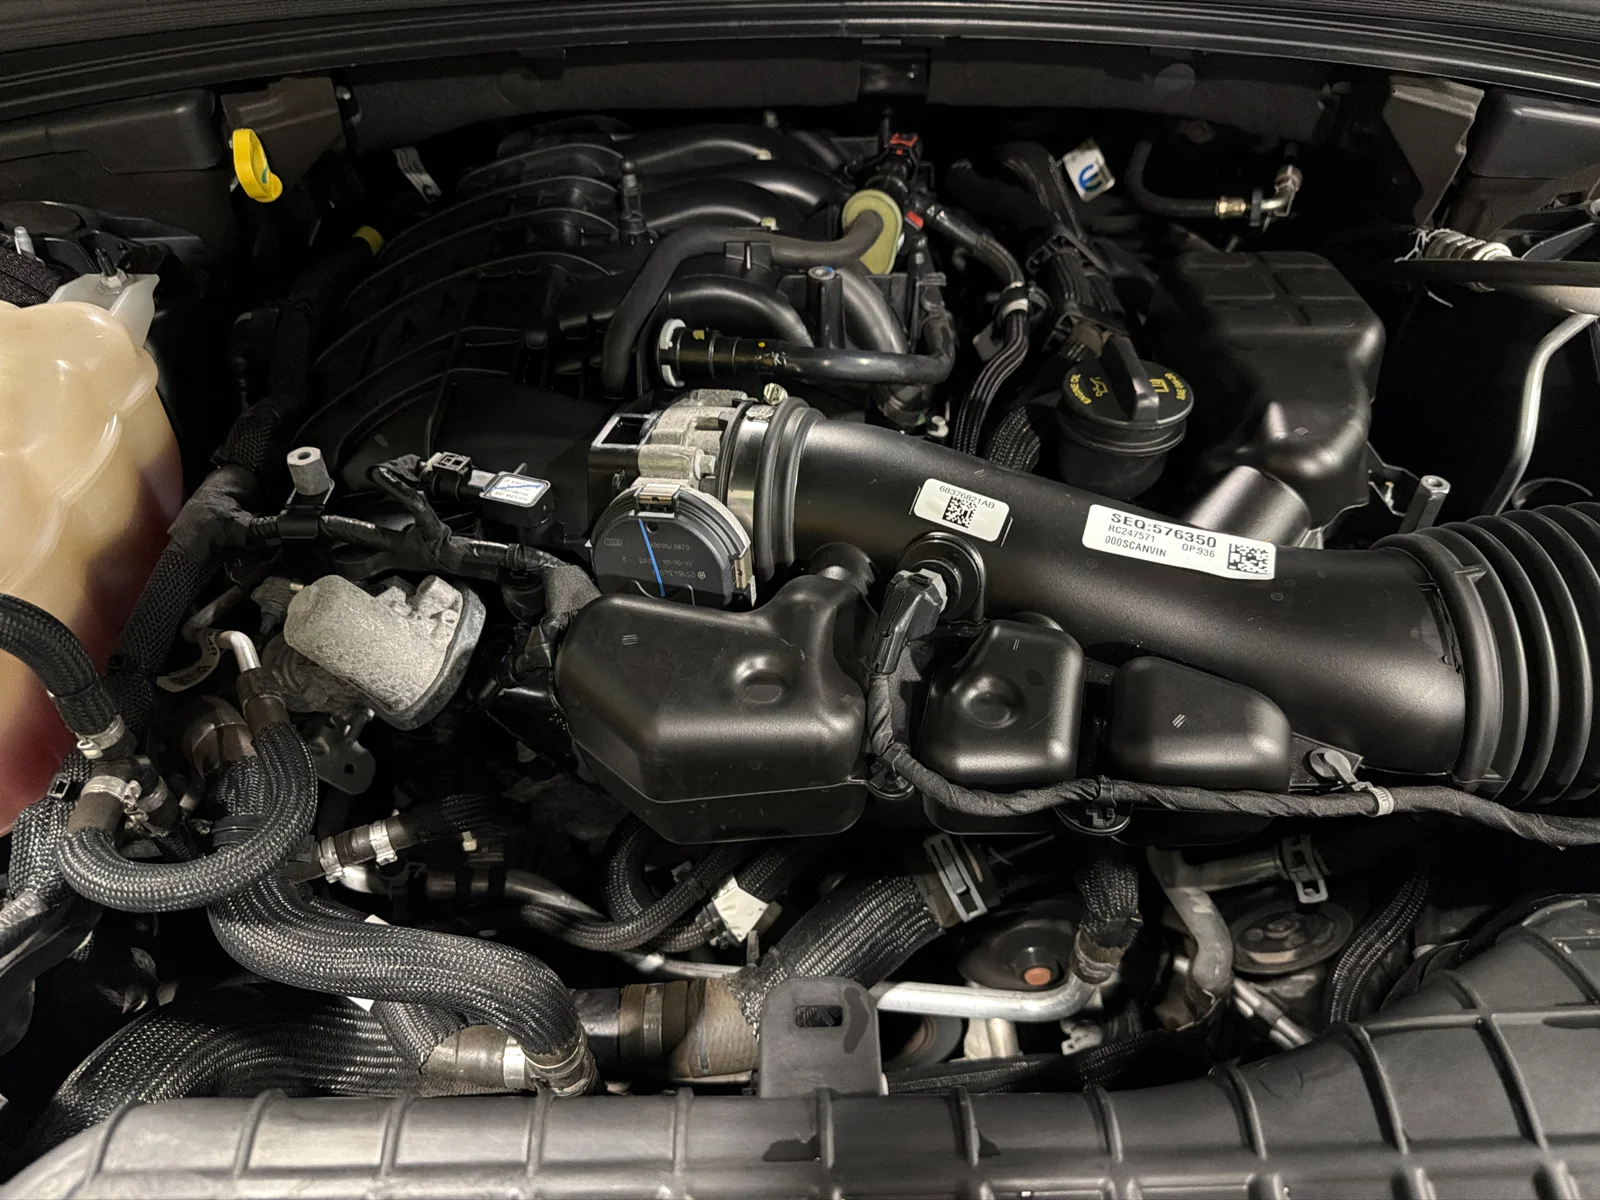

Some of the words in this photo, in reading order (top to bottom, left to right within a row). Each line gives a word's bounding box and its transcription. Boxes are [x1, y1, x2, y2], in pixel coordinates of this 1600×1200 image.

[940, 485, 995, 509] 68376821AB
[1108, 524, 1155, 543] RC247571
[1111, 513, 1217, 548] SEQ:576350
[1105, 535, 1167, 557] 000SCANVIN
